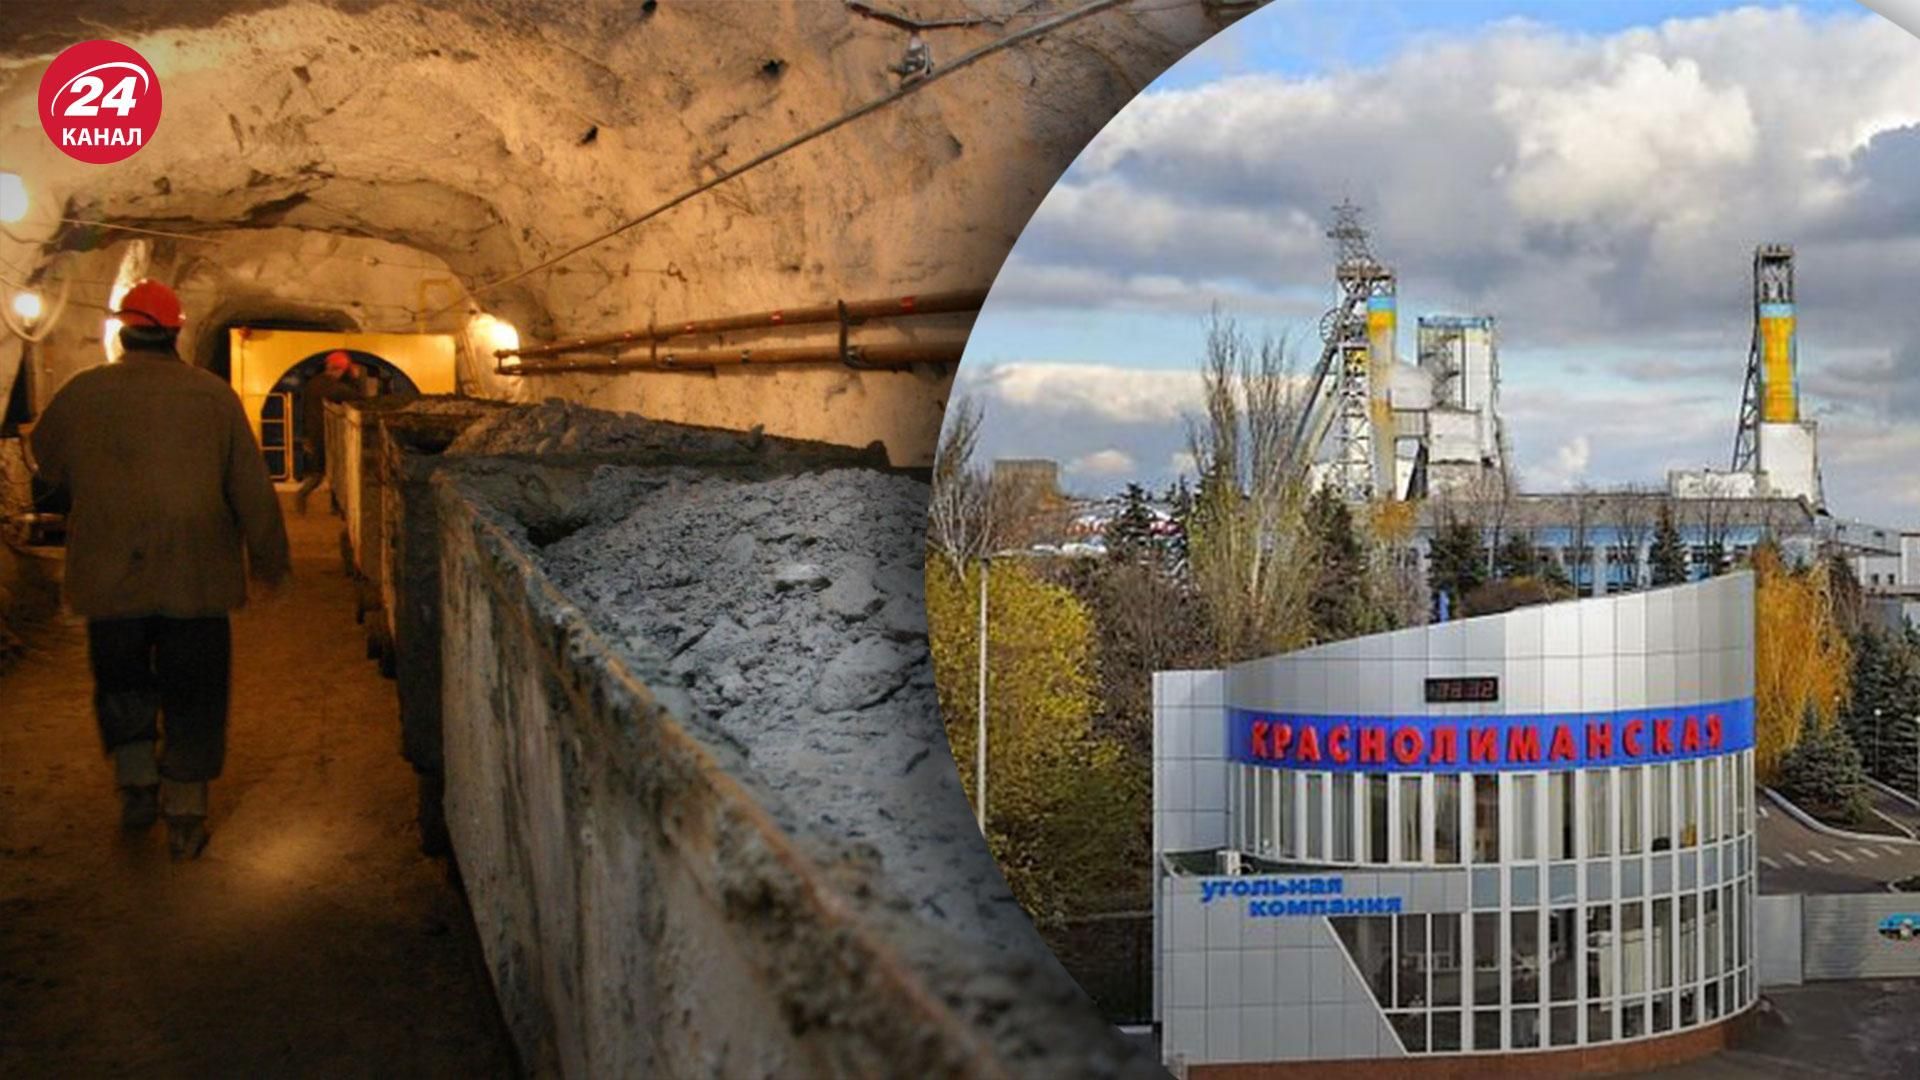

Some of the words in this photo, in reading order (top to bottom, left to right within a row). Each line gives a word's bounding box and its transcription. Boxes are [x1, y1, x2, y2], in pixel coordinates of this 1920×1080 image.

[1251, 715, 1723, 763] КРАСНОЛИМАНСКАЯ
[1200, 877, 1343, 902] угольная
[1249, 897, 1402, 917] компания
